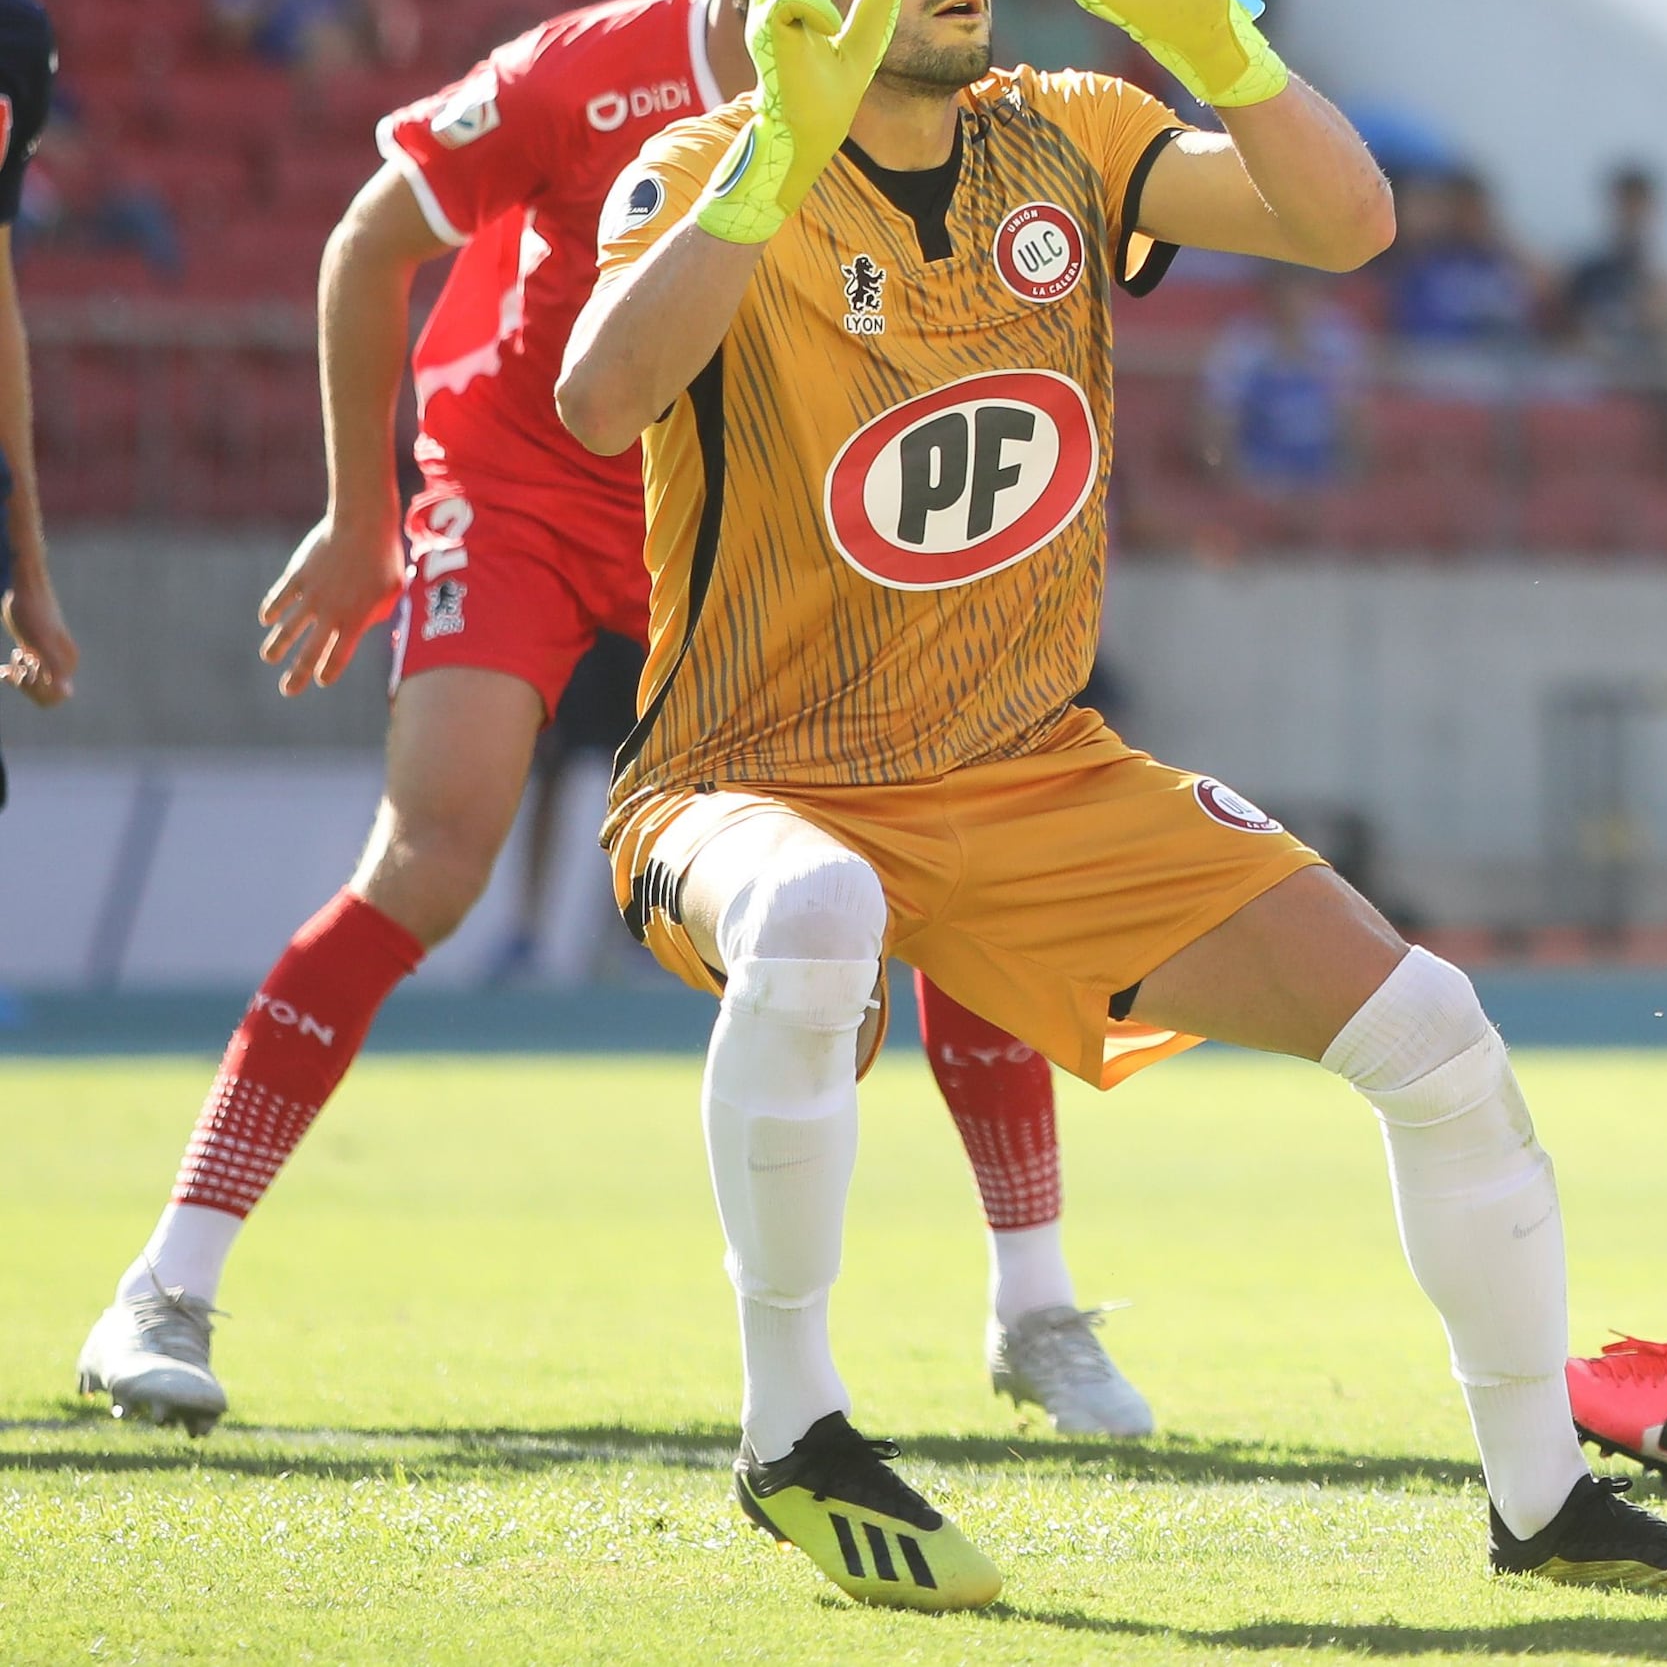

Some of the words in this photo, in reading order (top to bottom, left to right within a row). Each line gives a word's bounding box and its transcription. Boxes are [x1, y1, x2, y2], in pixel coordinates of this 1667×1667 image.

[629, 77, 692, 118] DiDi
[1007, 208, 1039, 233] UNIÓN
[1017, 230, 1063, 274] ULC
[1032, 286, 1047, 297] LA
[1049, 261, 1080, 295] CALERA
[845, 315, 884, 333] LYON
[897, 405, 1036, 546] PF
[942, 1042, 1036, 1067] LYO
